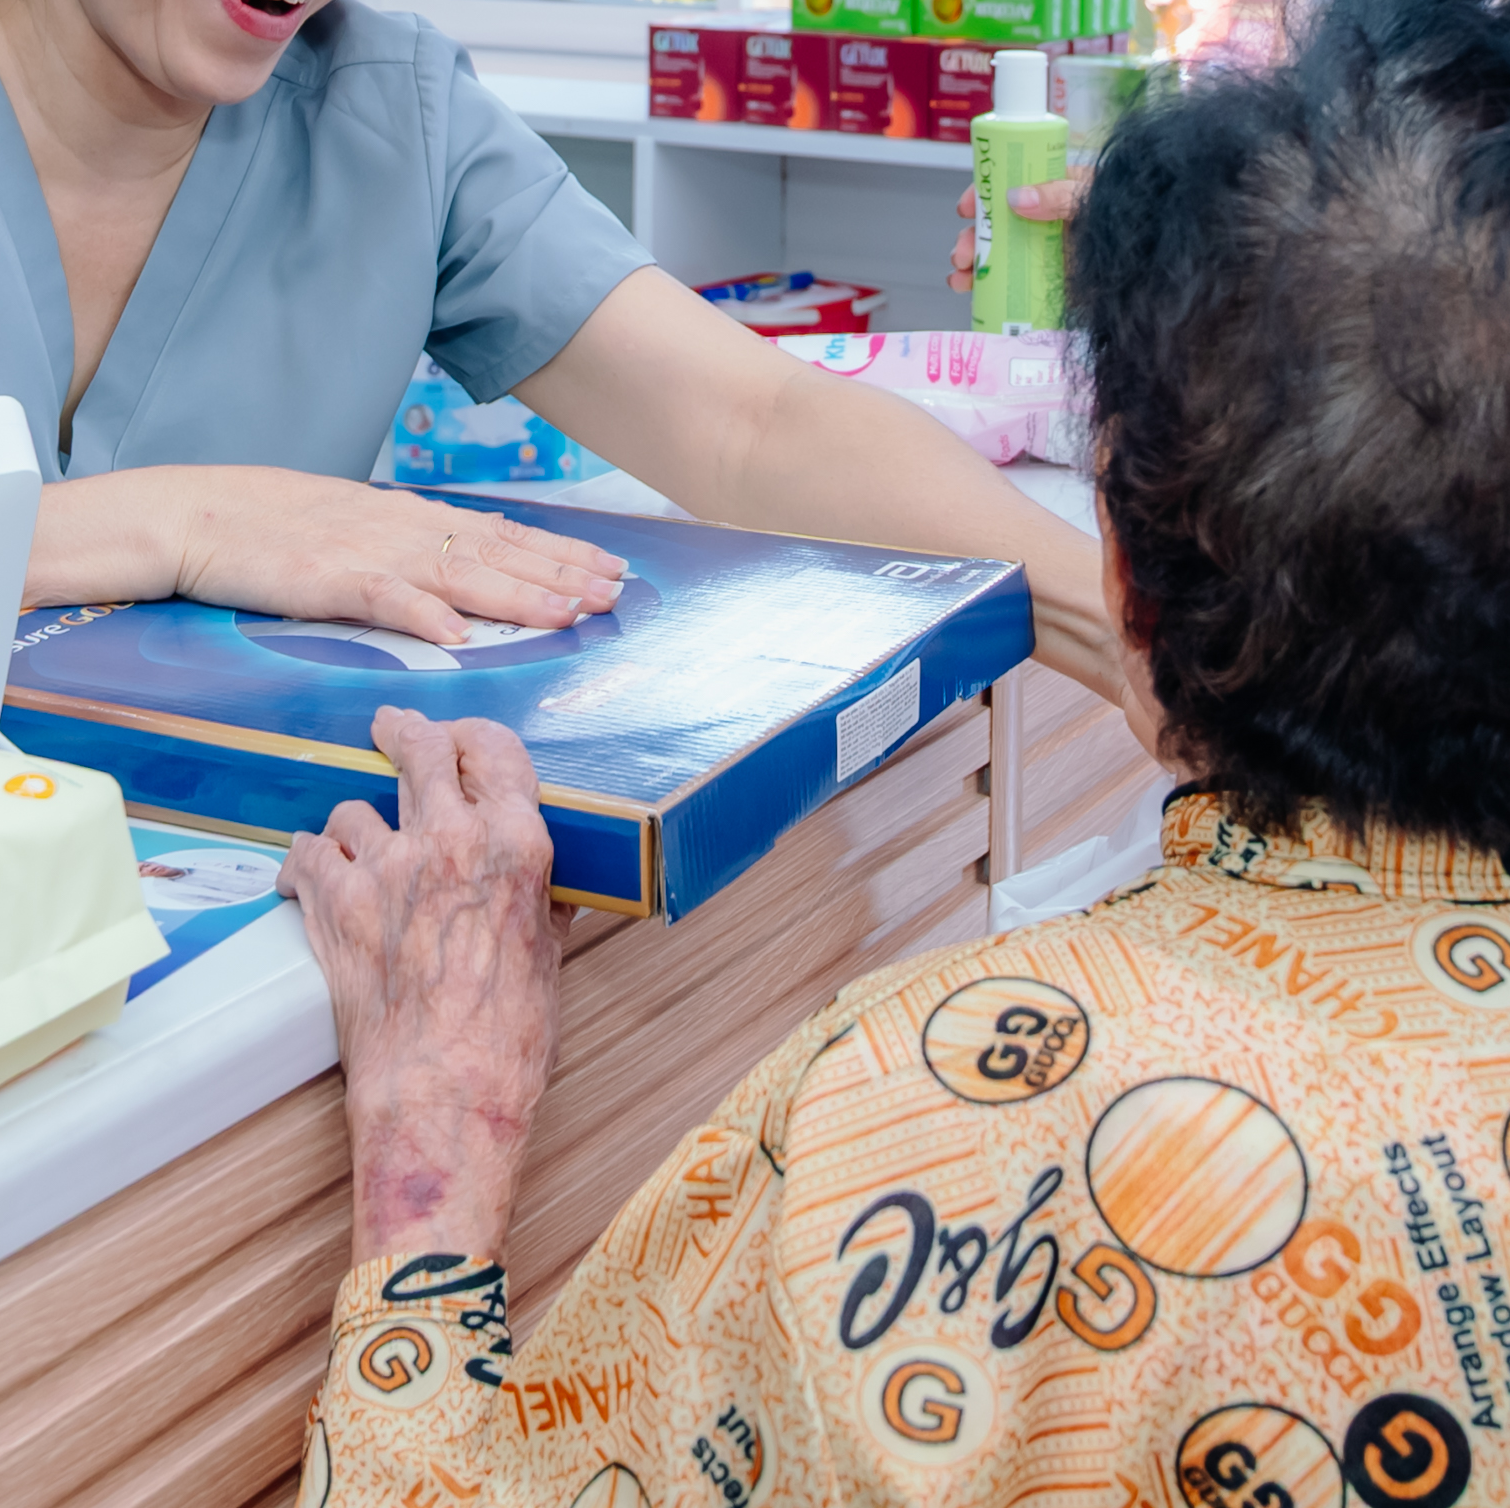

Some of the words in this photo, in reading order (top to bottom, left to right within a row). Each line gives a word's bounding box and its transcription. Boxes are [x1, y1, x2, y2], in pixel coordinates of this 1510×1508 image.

[977, 136, 1006, 244] Lactacyd
[1178, 902, 1399, 1039] CHANEL
[1381, 1140, 1451, 1274] Effects
[1420, 1131, 1493, 1264] Layout
[1055, 1242, 1158, 1352] G
[1248, 1269, 1372, 1397] GUCCI
[1437, 1282, 1502, 1431] Arrange
[359, 1325, 433, 1394] G
[881, 1358, 968, 1444] G
[1363, 1409, 1450, 1503] G
